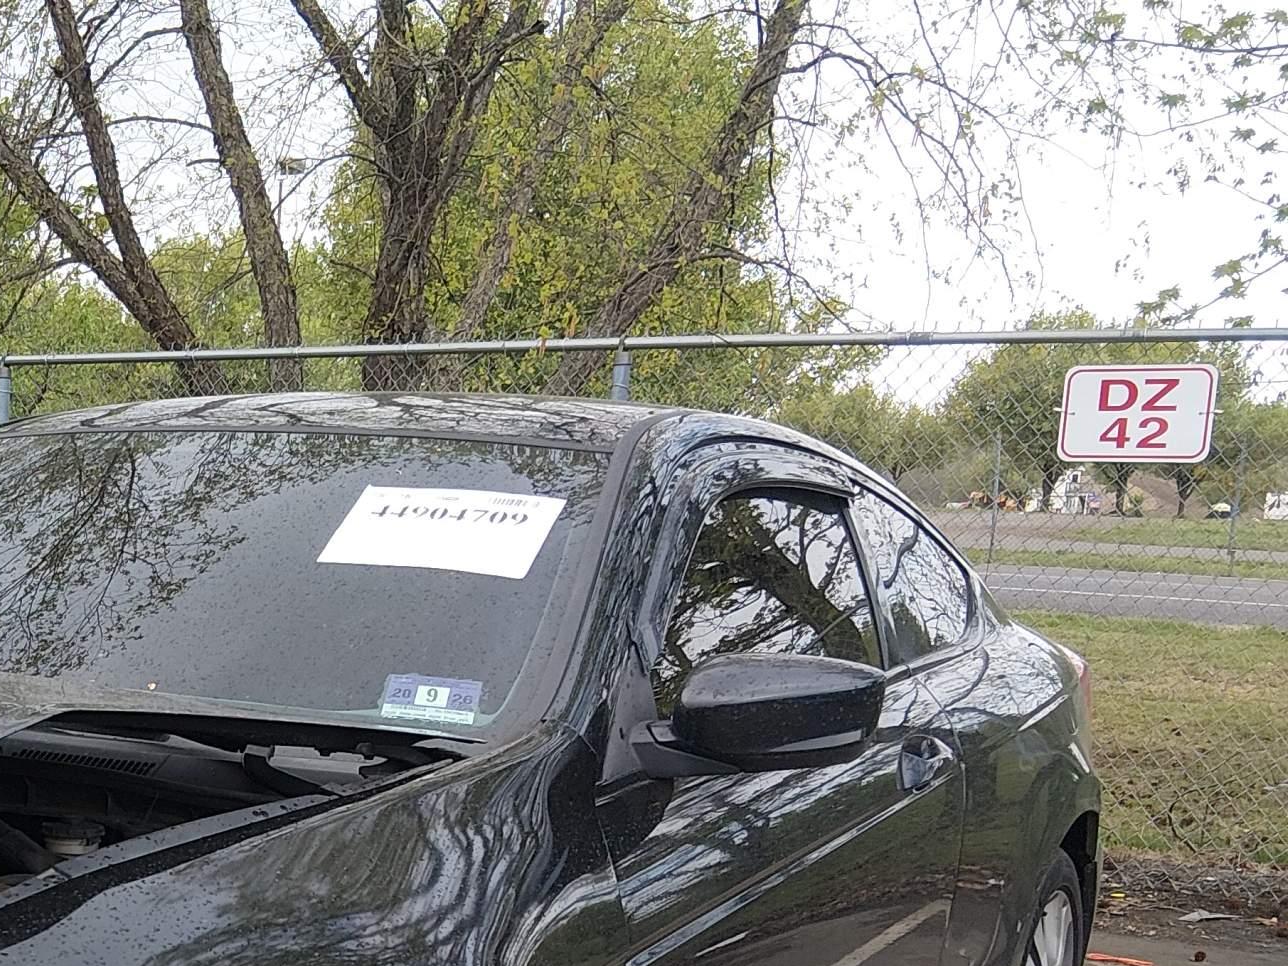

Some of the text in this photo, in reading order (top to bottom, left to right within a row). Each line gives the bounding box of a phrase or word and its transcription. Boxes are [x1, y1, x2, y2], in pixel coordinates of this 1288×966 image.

[1098, 379, 1180, 411] DZ
[1099, 417, 1169, 448] 42
[370, 504, 529, 527] 44904709
[390, 687, 412, 699] 20
[425, 688, 438, 703] 9
